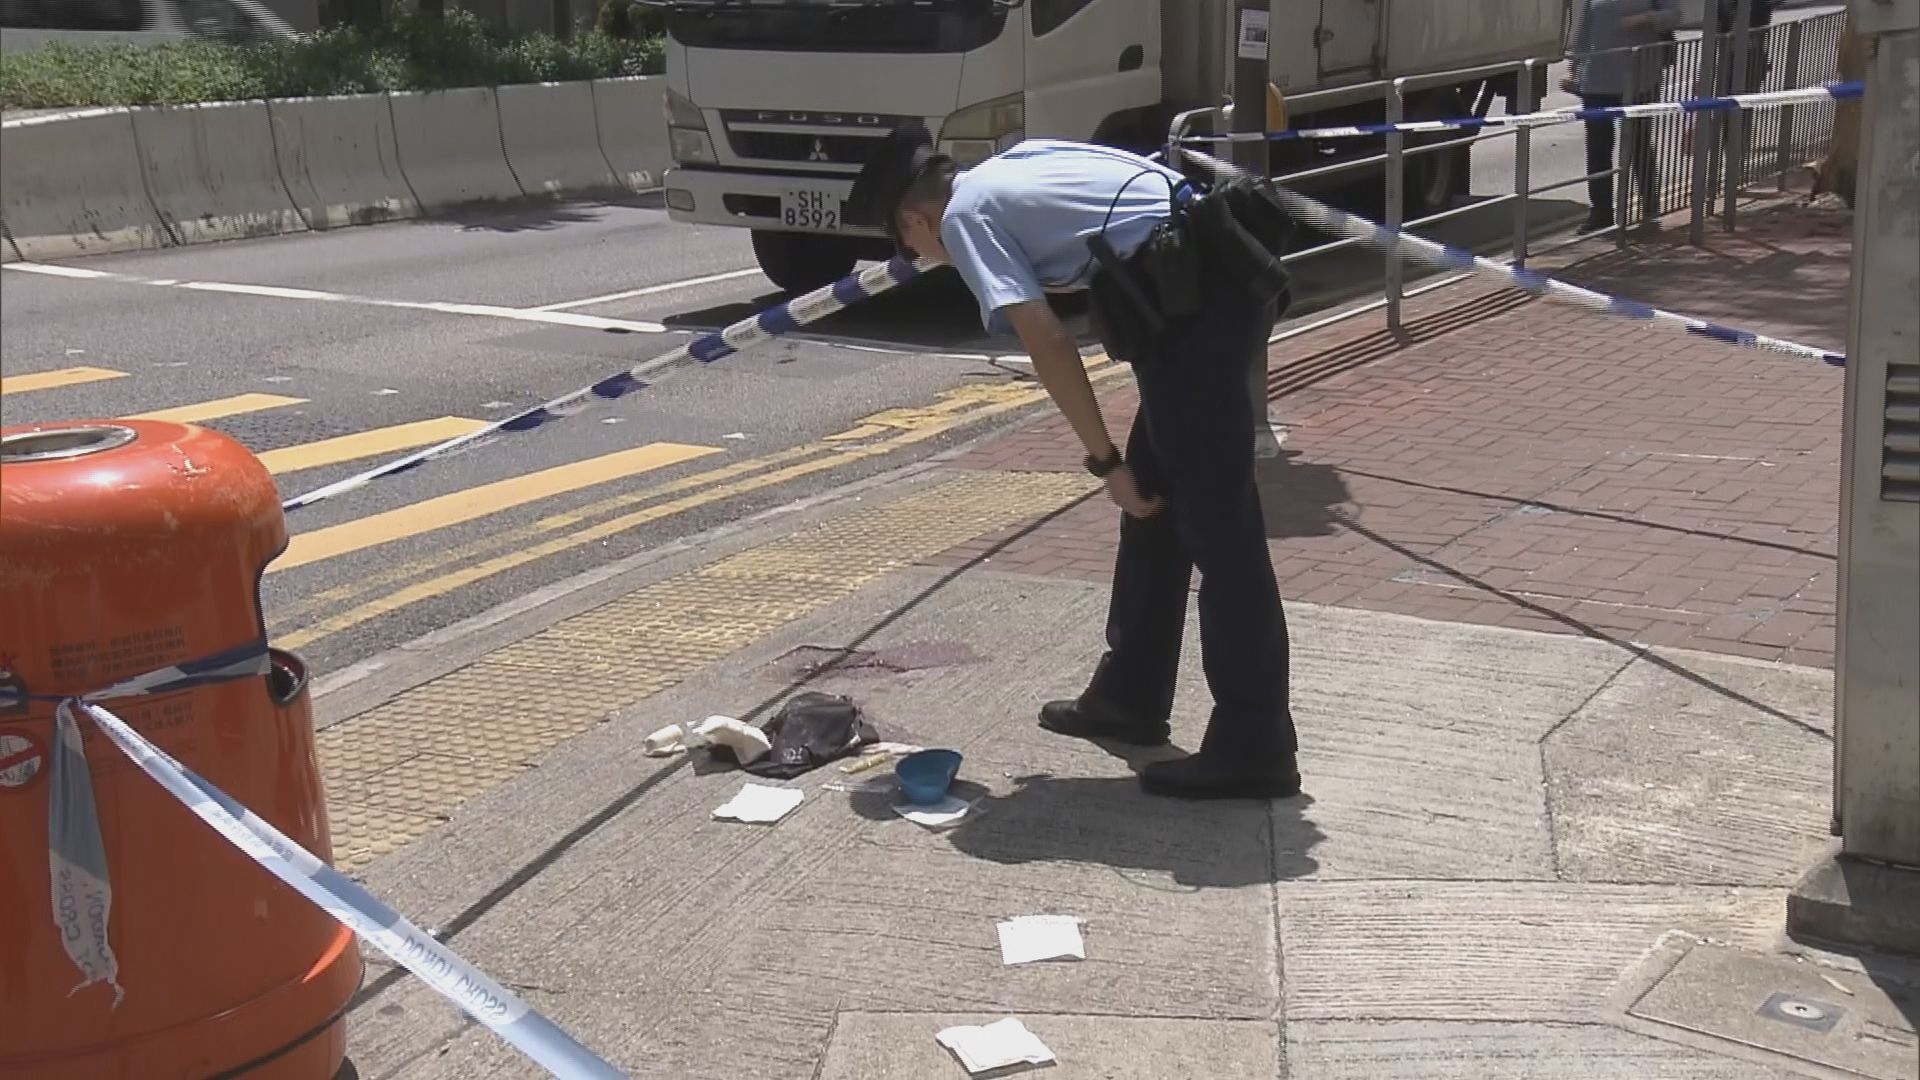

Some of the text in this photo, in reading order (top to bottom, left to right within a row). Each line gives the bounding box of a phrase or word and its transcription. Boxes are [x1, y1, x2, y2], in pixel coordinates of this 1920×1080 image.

[757, 111, 880, 124] FUSO
[798, 190, 823, 209] SH
[785, 207, 837, 229] 8592
